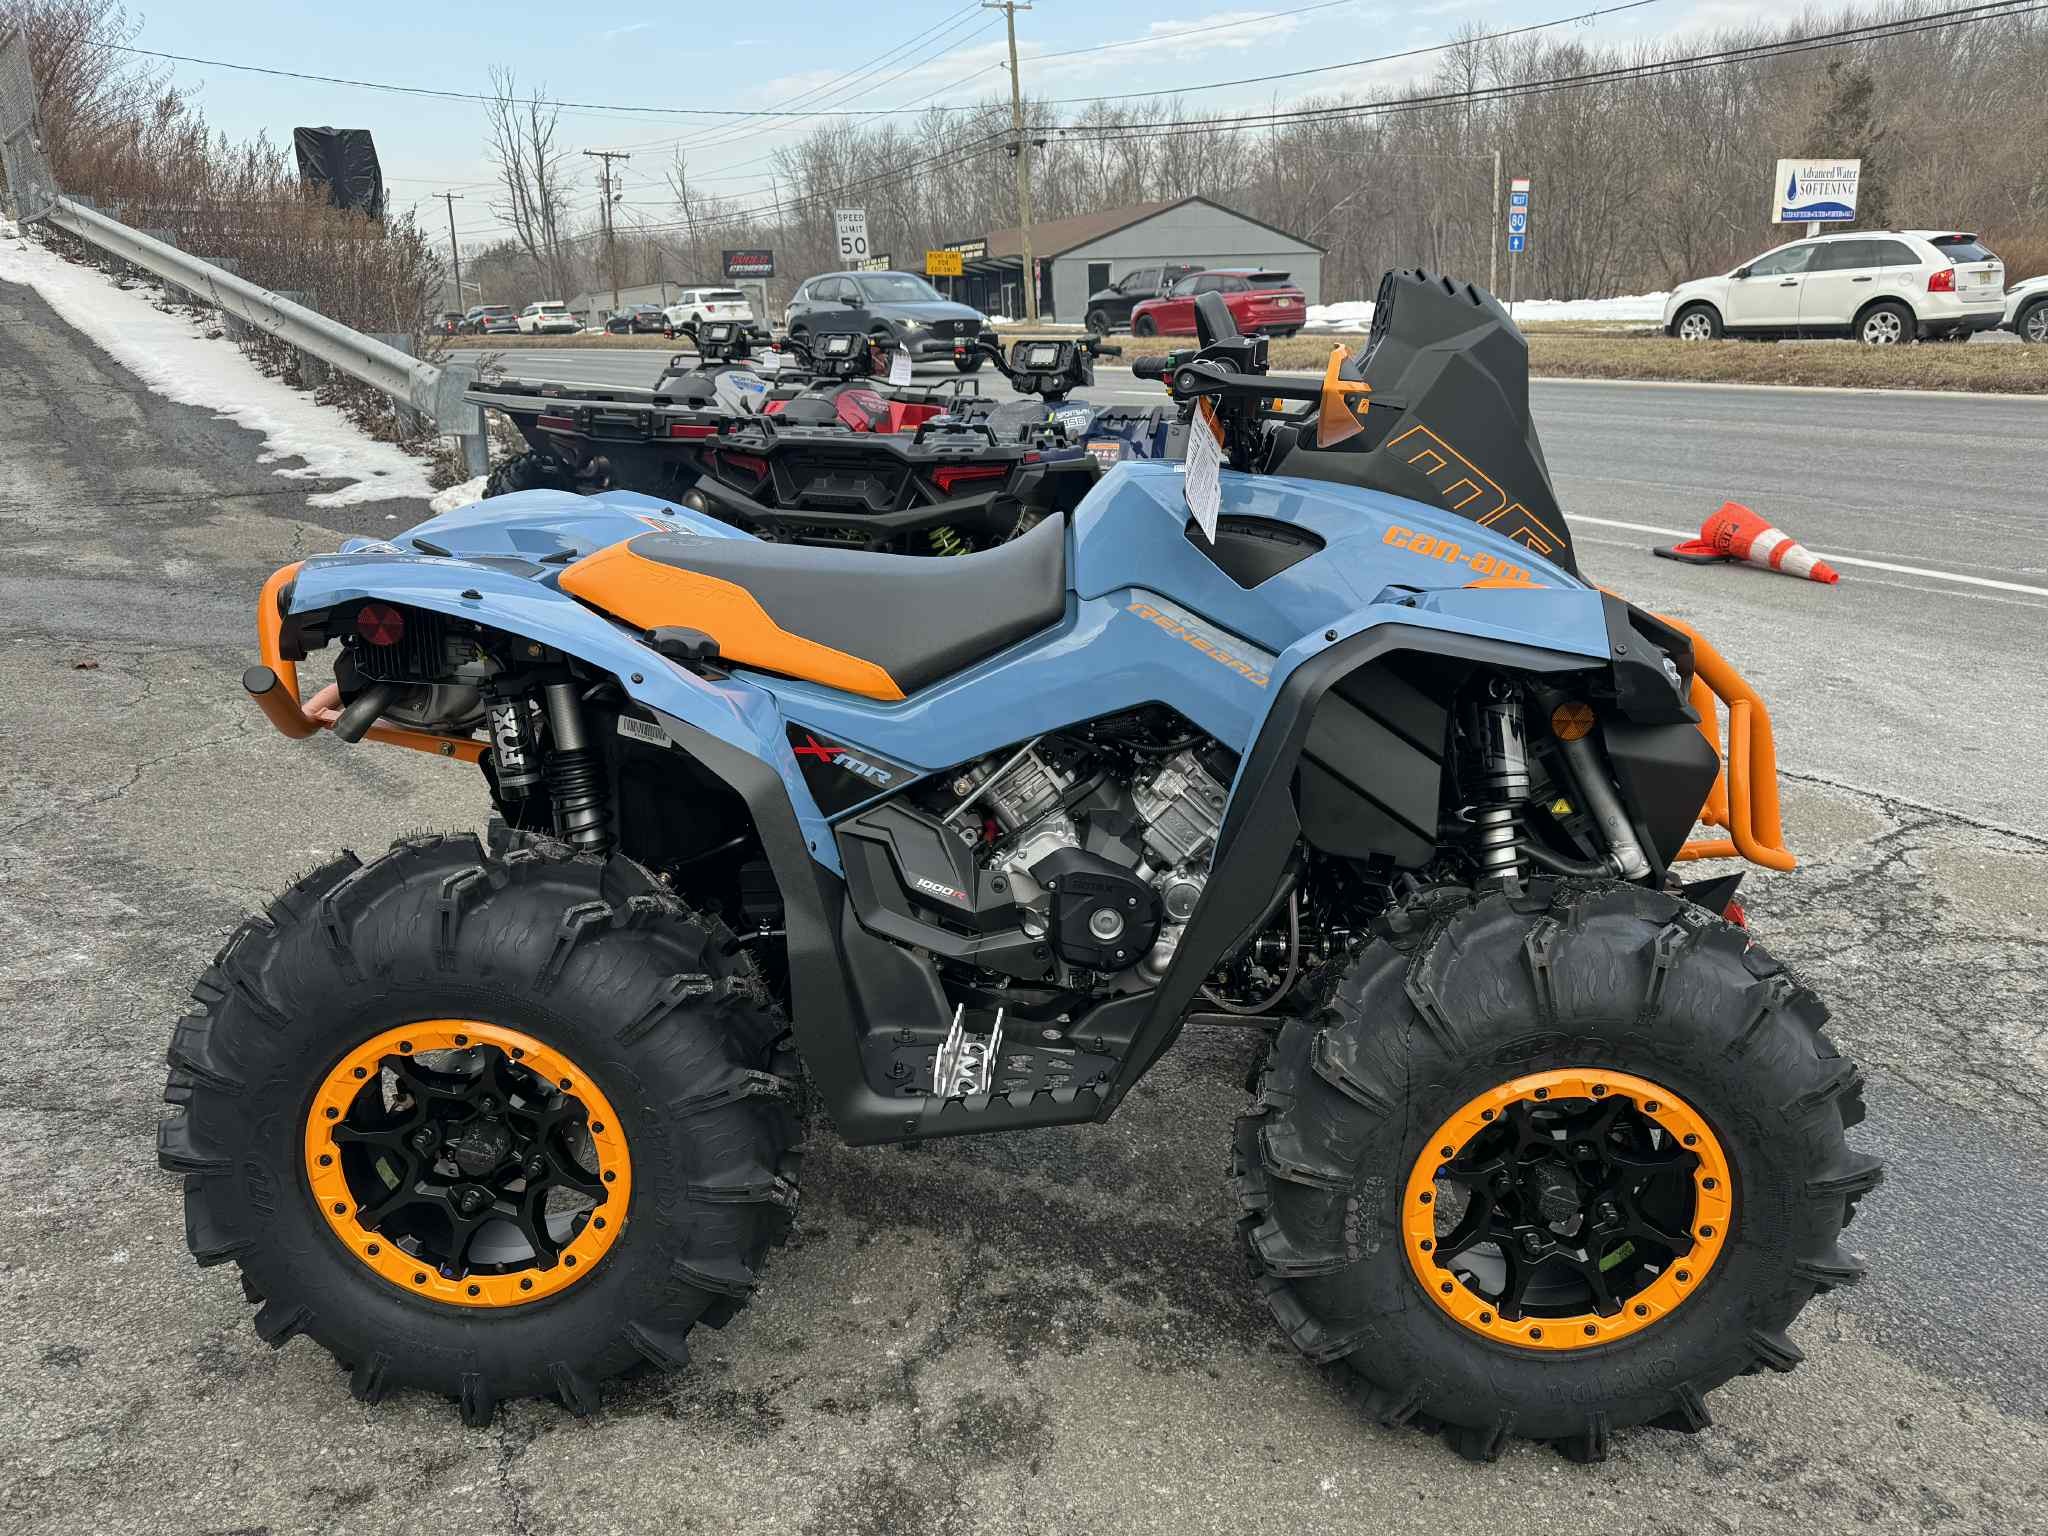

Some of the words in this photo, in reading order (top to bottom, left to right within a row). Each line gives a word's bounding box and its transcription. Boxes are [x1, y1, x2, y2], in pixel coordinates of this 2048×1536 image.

[1801, 167, 1834, 179] Advanced
[1834, 166, 1857, 179] Water
[1800, 182, 1855, 195] SOFTENING
[838, 213, 864, 222] SPEED
[1511, 214, 1524, 227] 80
[840, 224, 864, 233] LIMIT
[841, 236, 866, 254] 50
[492, 708, 526, 768] FOX
[916, 878, 969, 901] 1000R
